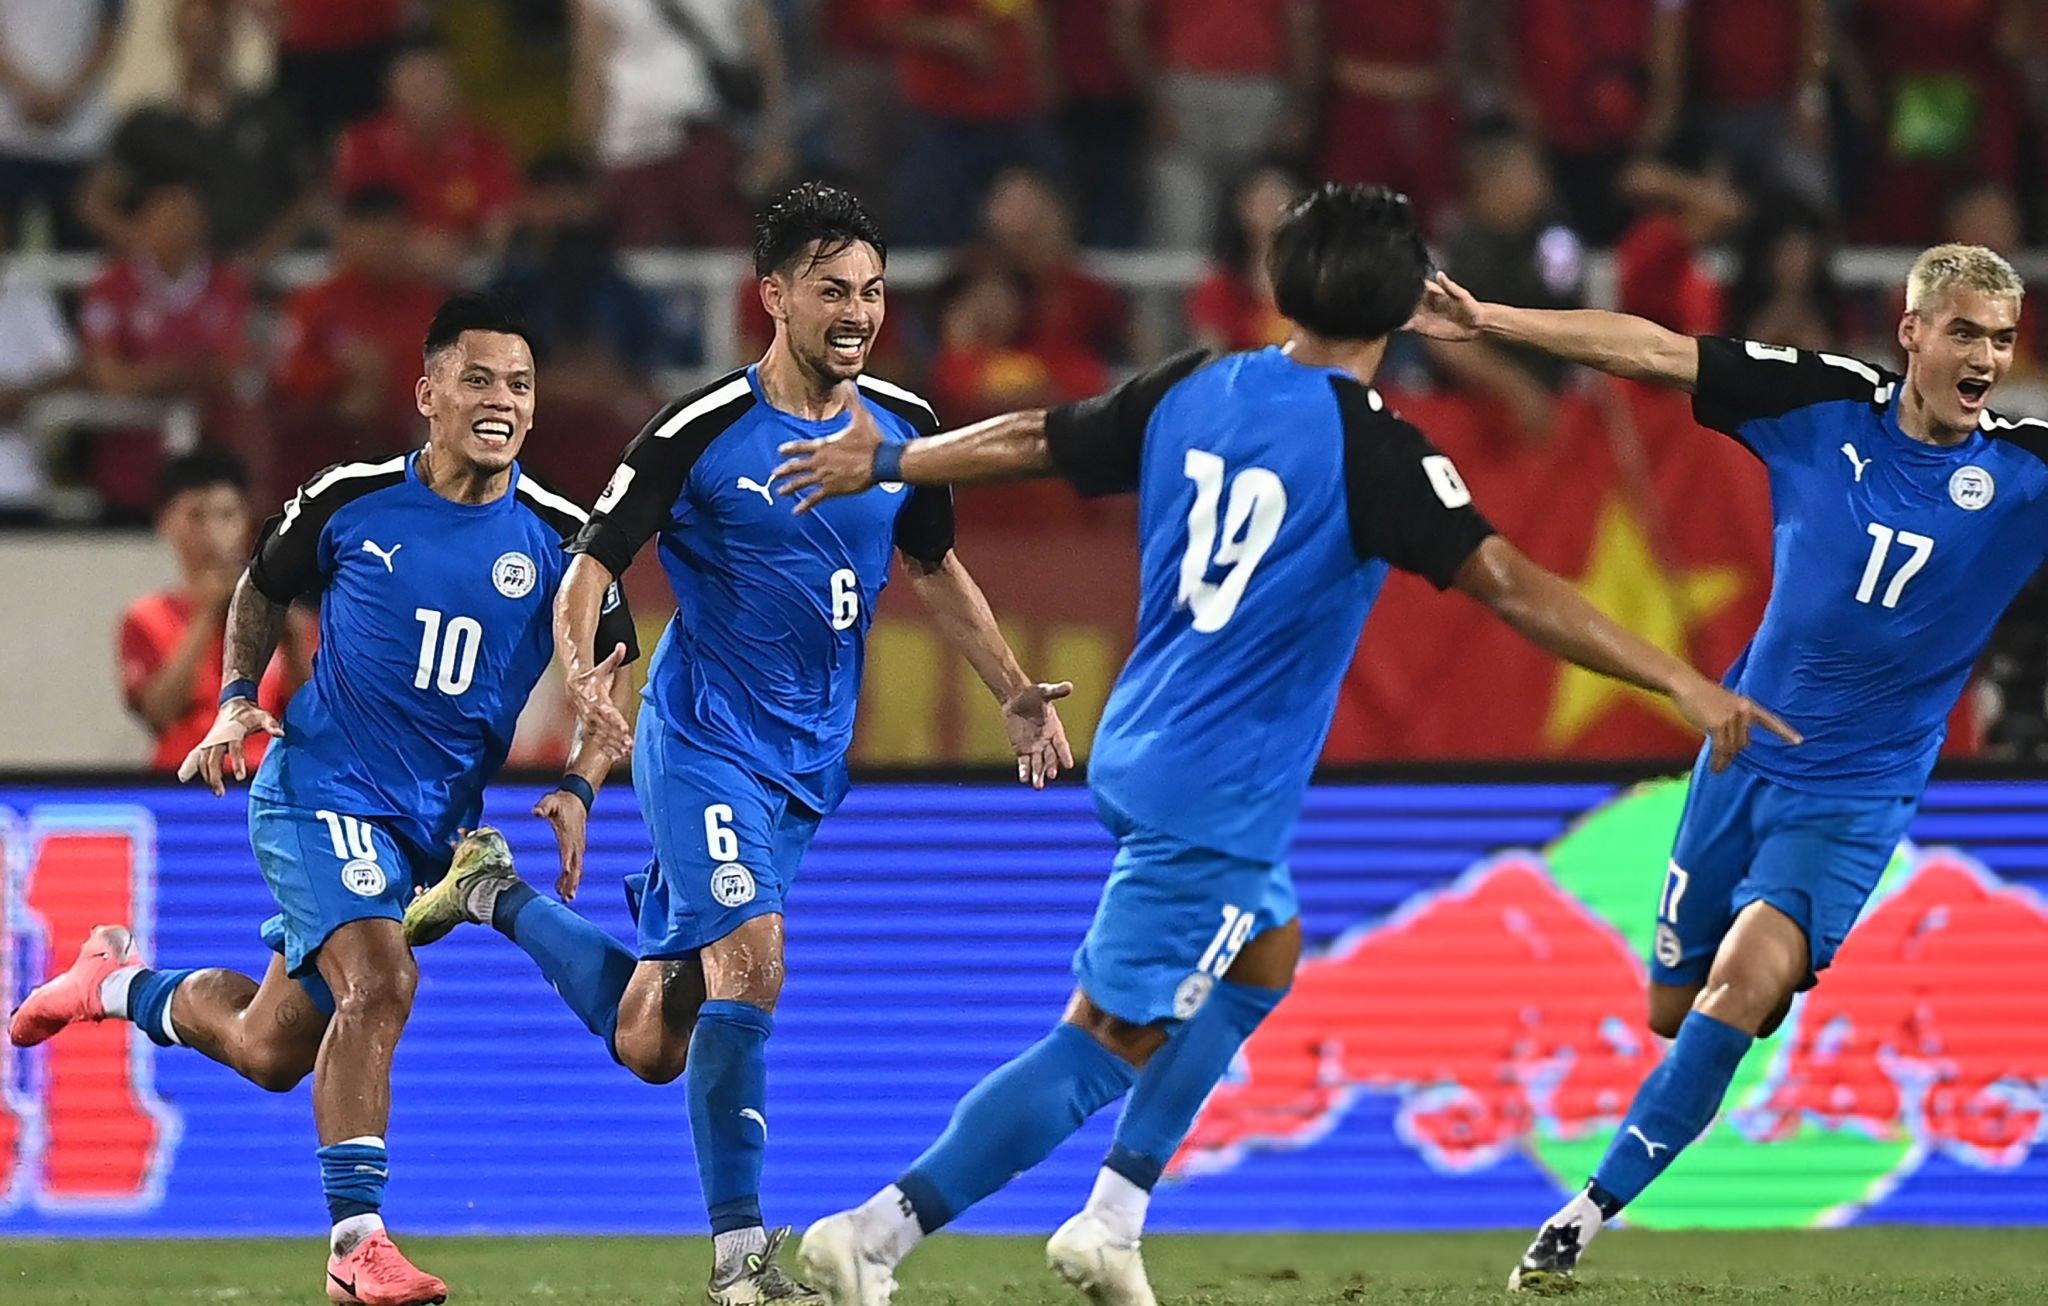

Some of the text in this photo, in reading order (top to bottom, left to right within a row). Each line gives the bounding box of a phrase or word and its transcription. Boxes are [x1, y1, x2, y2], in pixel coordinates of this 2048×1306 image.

[1173, 448, 1287, 633] 19
[1855, 522, 1934, 608] 17
[503, 576, 525, 587] PFF
[830, 568, 858, 631] 6
[413, 607, 482, 695] 10
[314, 809, 378, 861] 10
[703, 803, 739, 861] 6
[1196, 903, 1255, 980] 19
